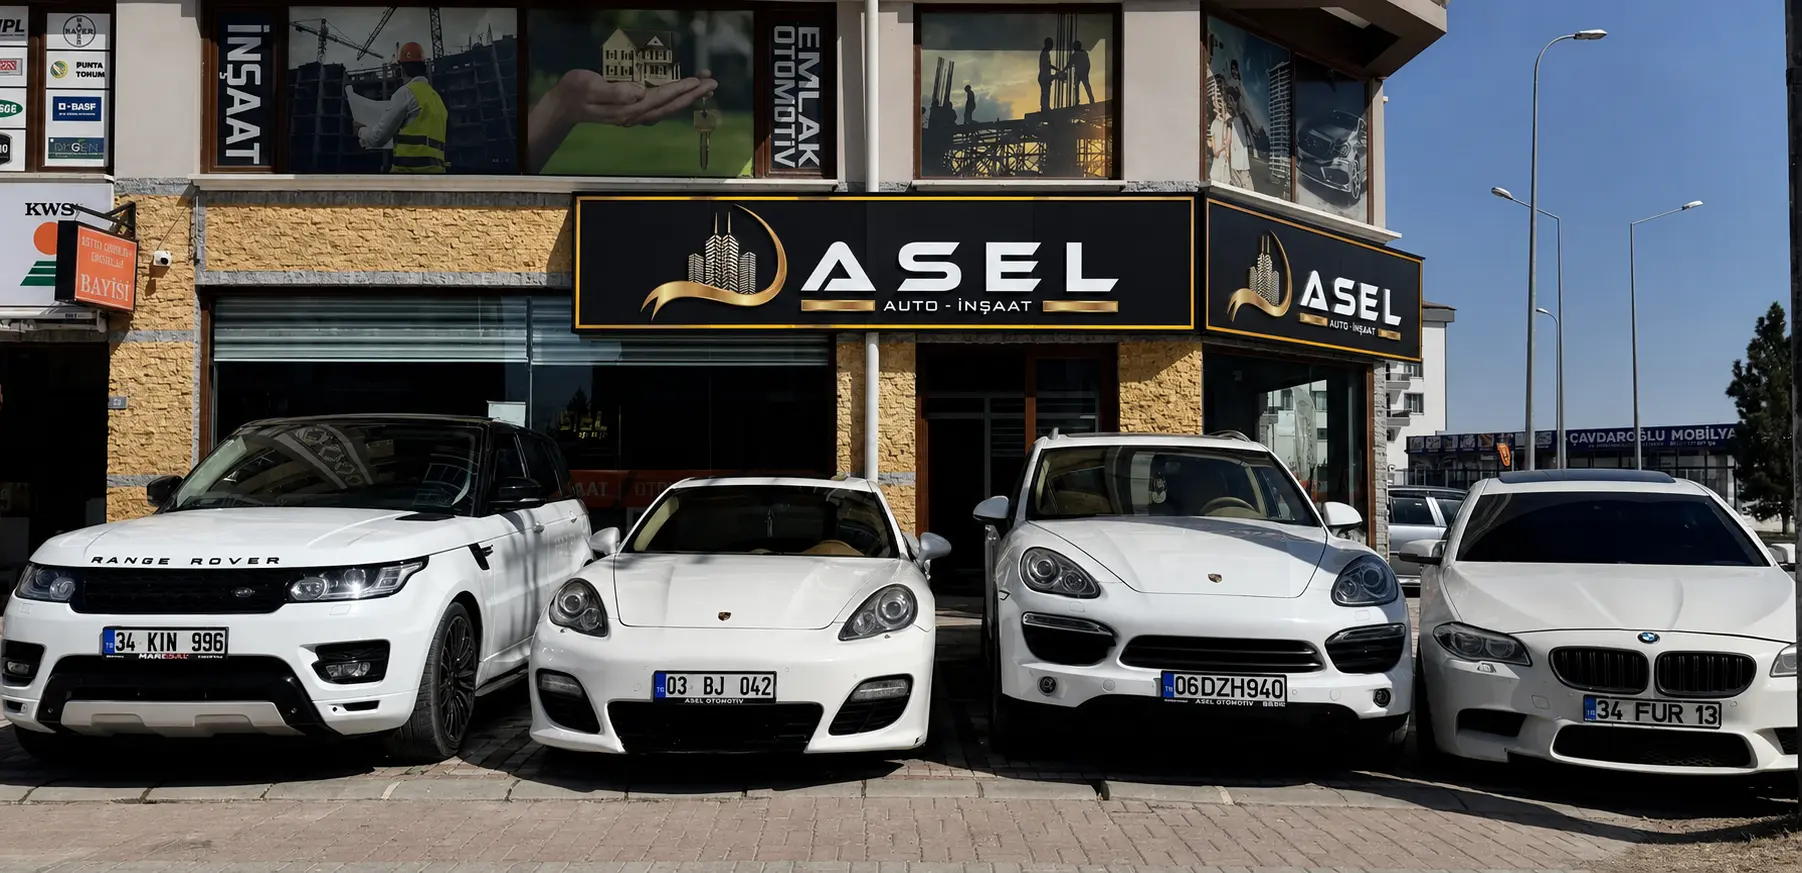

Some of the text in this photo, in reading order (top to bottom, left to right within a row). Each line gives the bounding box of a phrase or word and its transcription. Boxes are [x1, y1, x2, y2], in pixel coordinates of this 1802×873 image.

[0, 19, 25, 32] PL
[219, 24, 271, 165] İNŞAAT
[773, 25, 796, 168] OTOMOTİV
[798, 26, 820, 168] EMLAK
[71, 103, 97, 111] BASF
[25, 202, 75, 216] KWS
[800, 241, 1119, 292] ASEL
[80, 273, 130, 302] BAYİSİ
[1299, 270, 1402, 325] ASEL
[883, 300, 938, 312] AUTO
[958, 298, 1032, 314] İNŞAAT
[1329, 319, 1349, 331] AUTO
[1569, 429, 1666, 447] ÇAVDAROĞLU
[1671, 426, 1736, 441] MOBİLYA
[575, 481, 609, 496] AAT
[91, 556, 281, 566] RANGE ROVER
[115, 632, 223, 652] 34 KIN 996
[667, 676, 771, 696] 03 BJ 042
[1175, 675, 1284, 698] 06DZH940
[1597, 700, 1718, 724] 34 FUR 13
